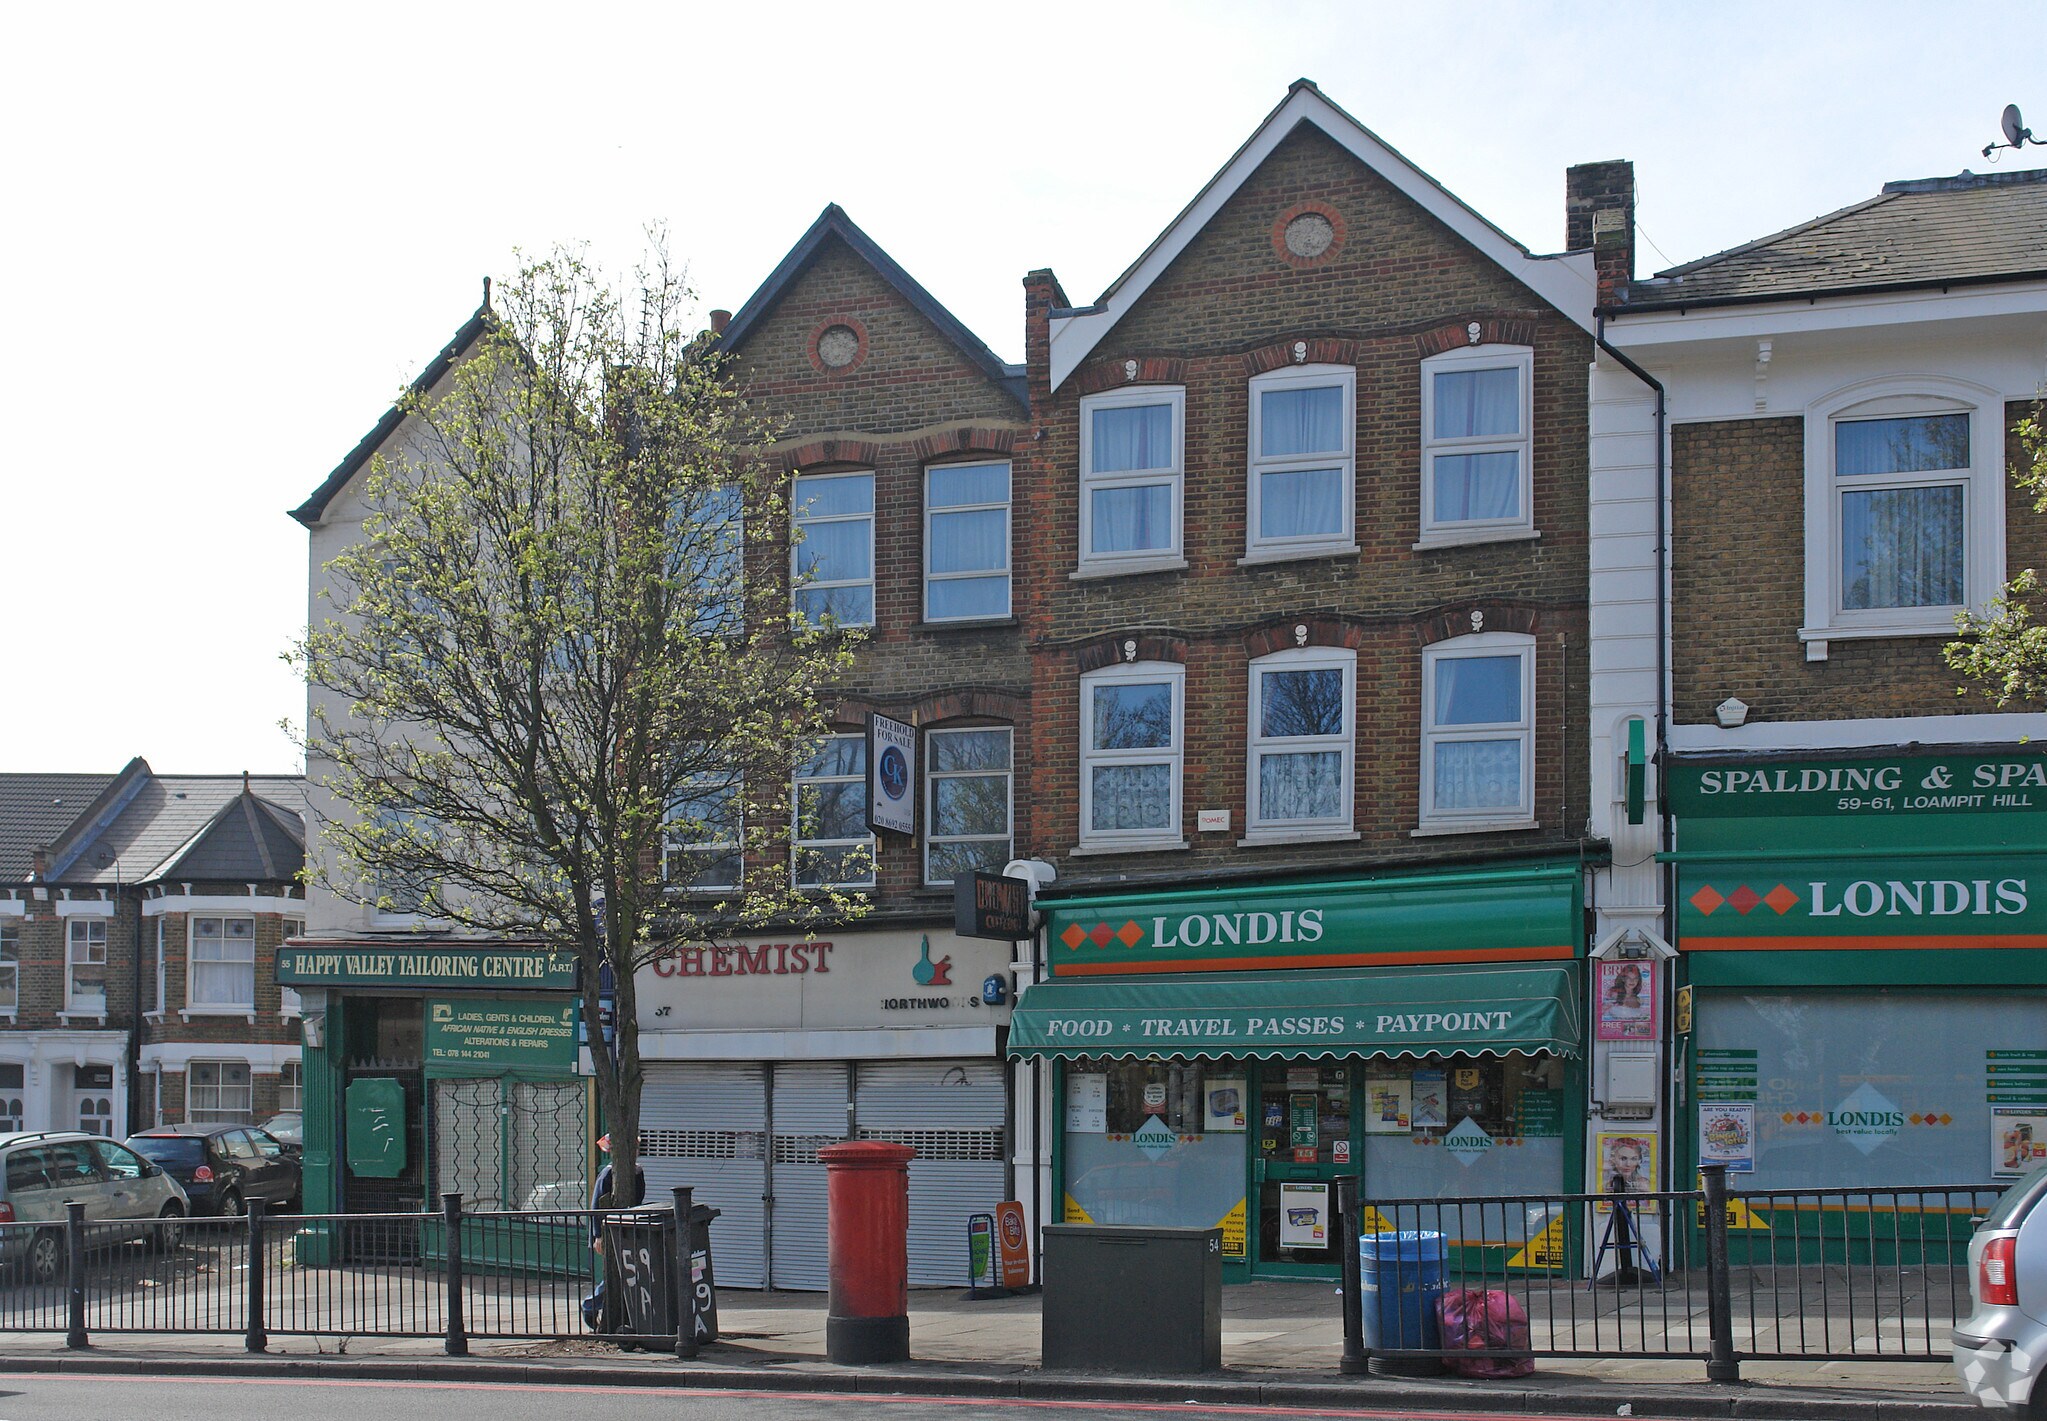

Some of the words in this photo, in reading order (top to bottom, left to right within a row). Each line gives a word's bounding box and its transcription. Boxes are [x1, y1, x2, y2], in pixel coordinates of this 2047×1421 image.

[875, 716, 915, 738] FREEHOLD
[877, 728, 894, 743] FOR
[894, 735, 912, 749] SALE
[1700, 766, 1903, 794] SPALDING
[1920, 765, 1953, 789] &
[1837, 796, 1895, 811] 59-61,
[1903, 794, 1985, 809] LOAMPIT
[1992, 793, 2033, 807] HILL
[1808, 878, 2028, 917] LONDIS
[1151, 909, 1324, 948] LONDIS
[281, 959, 291, 969] 55
[294, 955, 342, 975] HAPPY
[345, 955, 396, 975] VALLEY
[398, 955, 479, 977] TAILORING
[482, 956, 544, 978] CENTRE
[653, 942, 833, 977] CHEMIST
[486, 1013, 510, 1022] GENTS
[511, 1014, 517, 1022] &
[1046, 1019, 1113, 1037] FOOD
[1140, 1018, 1236, 1036] TRAVEL
[1246, 1016, 1344, 1035] PASSES
[1375, 1011, 1512, 1033] PAYPOINT
[441, 1024, 472, 1033] AFRICAN
[473, 1025, 498, 1034] NATIVE
[499, 1025, 506, 1034] &
[506, 1026, 538, 1035] ENGLISH
[539, 1028, 573, 1037] DRESSES
[463, 1037, 510, 1046] ALTERATIONS
[511, 1038, 517, 1046] &
[518, 1039, 549, 1048] REPAIRS
[1828, 1111, 1904, 1127] LONDIS
[1132, 1133, 1176, 1143] LONDIS
[1443, 1136, 1493, 1147] LONDIS
[1874, 1128, 1898, 1136] locally
[1209, 1239, 1219, 1252] 54
[622, 1248, 656, 1287] 59
[640, 1286, 656, 1321] A
[694, 1313, 708, 1338] A
